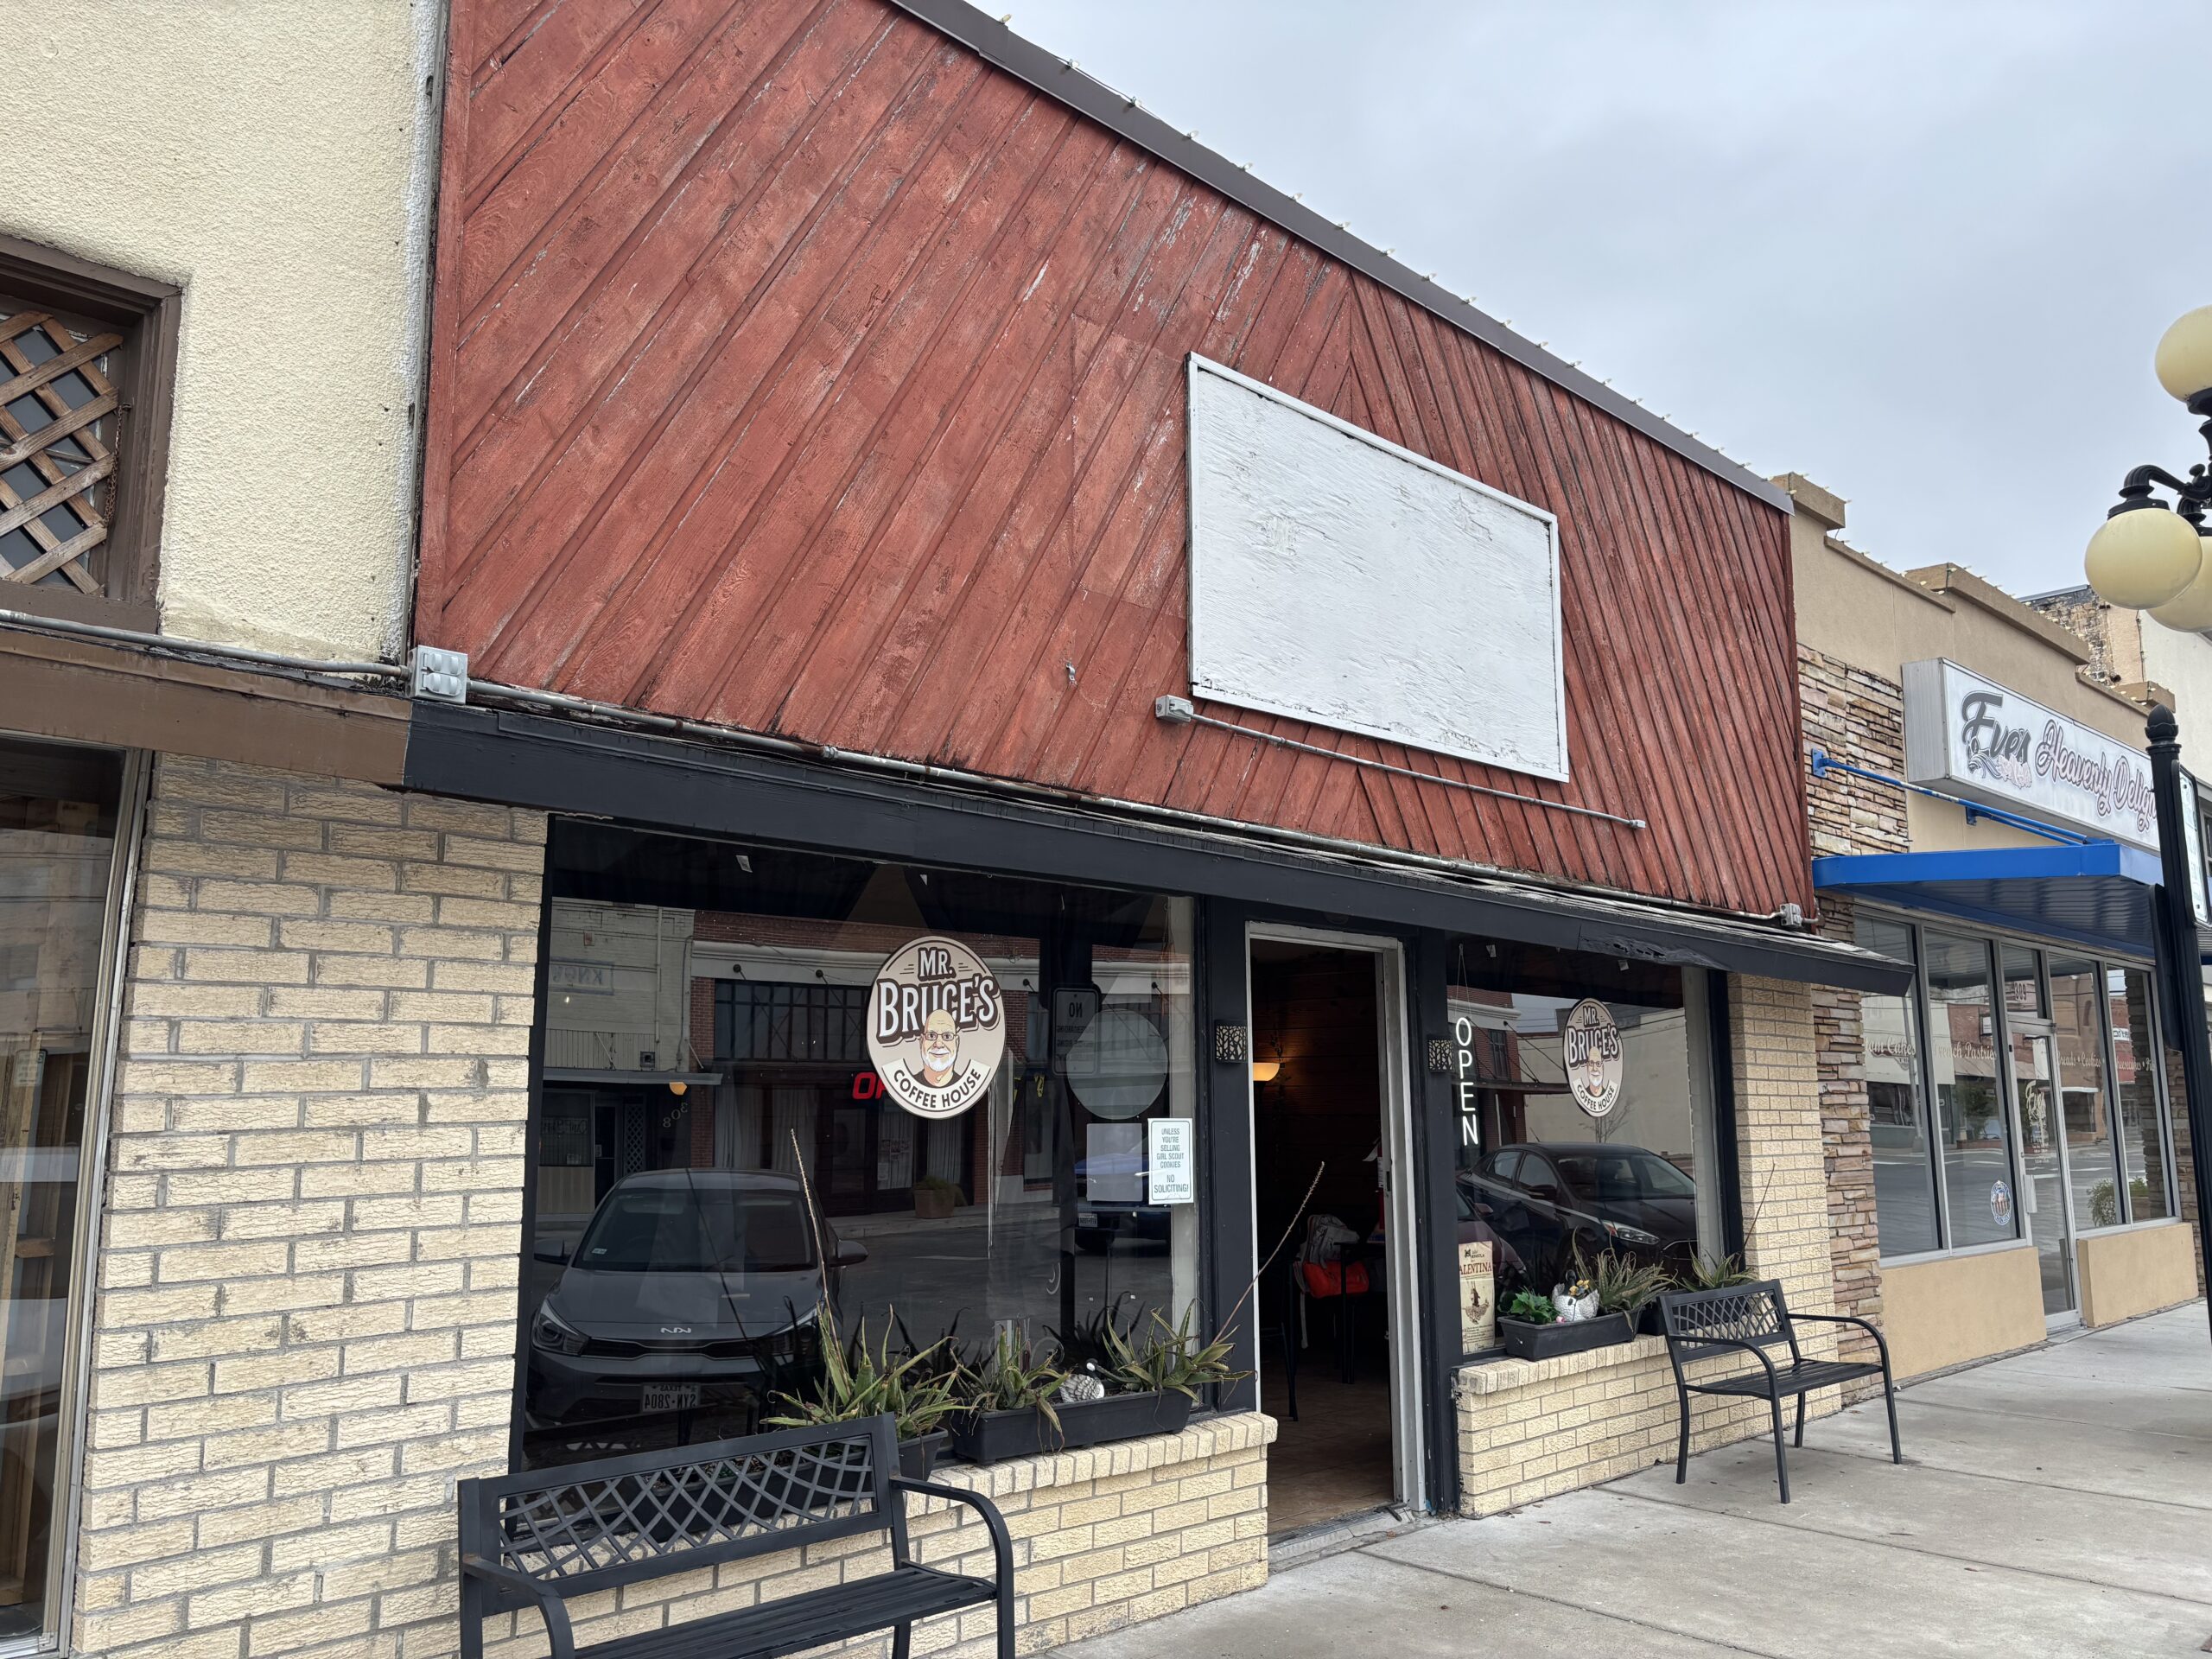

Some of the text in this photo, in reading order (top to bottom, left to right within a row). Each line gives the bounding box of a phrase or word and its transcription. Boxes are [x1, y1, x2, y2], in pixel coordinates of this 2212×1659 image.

[2036, 719, 2113, 817] Heavenly
[918, 948, 955, 980] MR.
[2014, 982, 2027, 1001] 309
[876, 975, 997, 1040] BRUCE'S
[1583, 1006, 1599, 1027] MR.
[1567, 1024, 1619, 1066] BRUCE'S
[1887, 1036, 1916, 1056] Cakes
[1964, 1041, 1997, 1060] Pastries
[2081, 1052, 2101, 1068] Cookies
[894, 1069, 982, 1108] COFFEE HOUSE
[1456, 1017, 1478, 1147] OPEN
[1577, 1084, 1615, 1110] COFFEE HOUSE
[1154, 1184, 1189, 1193] SOLICITING!
